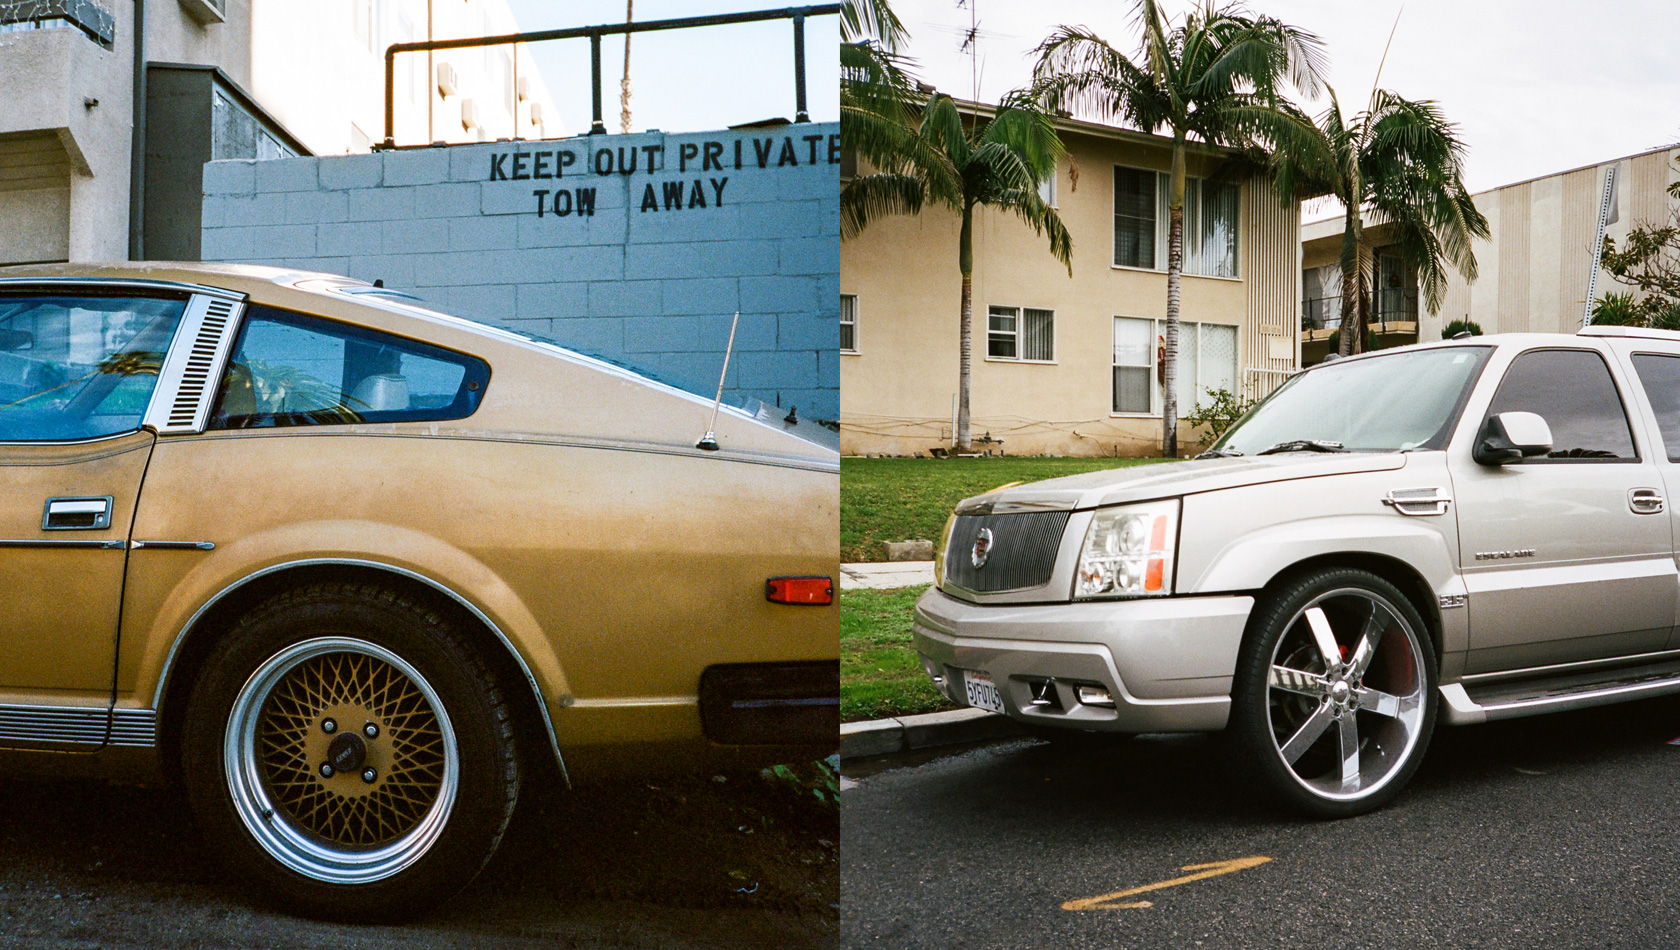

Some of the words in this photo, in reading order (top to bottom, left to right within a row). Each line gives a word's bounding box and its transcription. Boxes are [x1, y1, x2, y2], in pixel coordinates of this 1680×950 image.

[489, 150, 576, 181] KEEP
[594, 145, 661, 176] OUT
[679, 134, 840, 172] PRIVATE
[533, 188, 596, 218] TOW
[640, 177, 728, 213] AWAY
